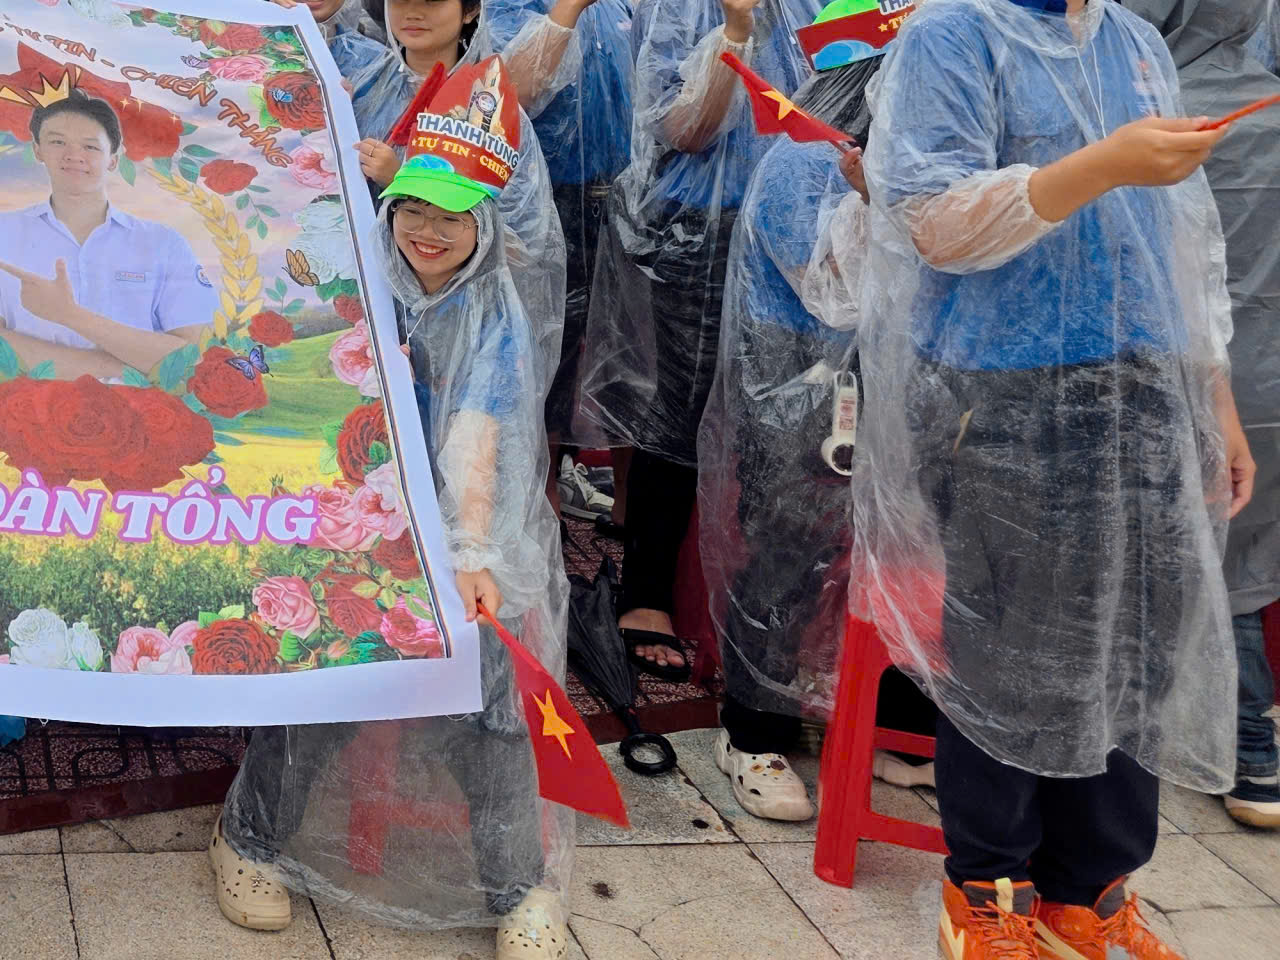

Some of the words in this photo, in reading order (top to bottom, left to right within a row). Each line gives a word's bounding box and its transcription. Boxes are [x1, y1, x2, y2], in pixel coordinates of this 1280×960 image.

[44, 34, 97, 62] TIN
[417, 136, 440, 152] TỰ
[441, 140, 470, 159] TIN
[418, 113, 484, 146] THANH
[486, 135, 520, 170] TÙNG
[118, 467, 318, 543] TỔNG
